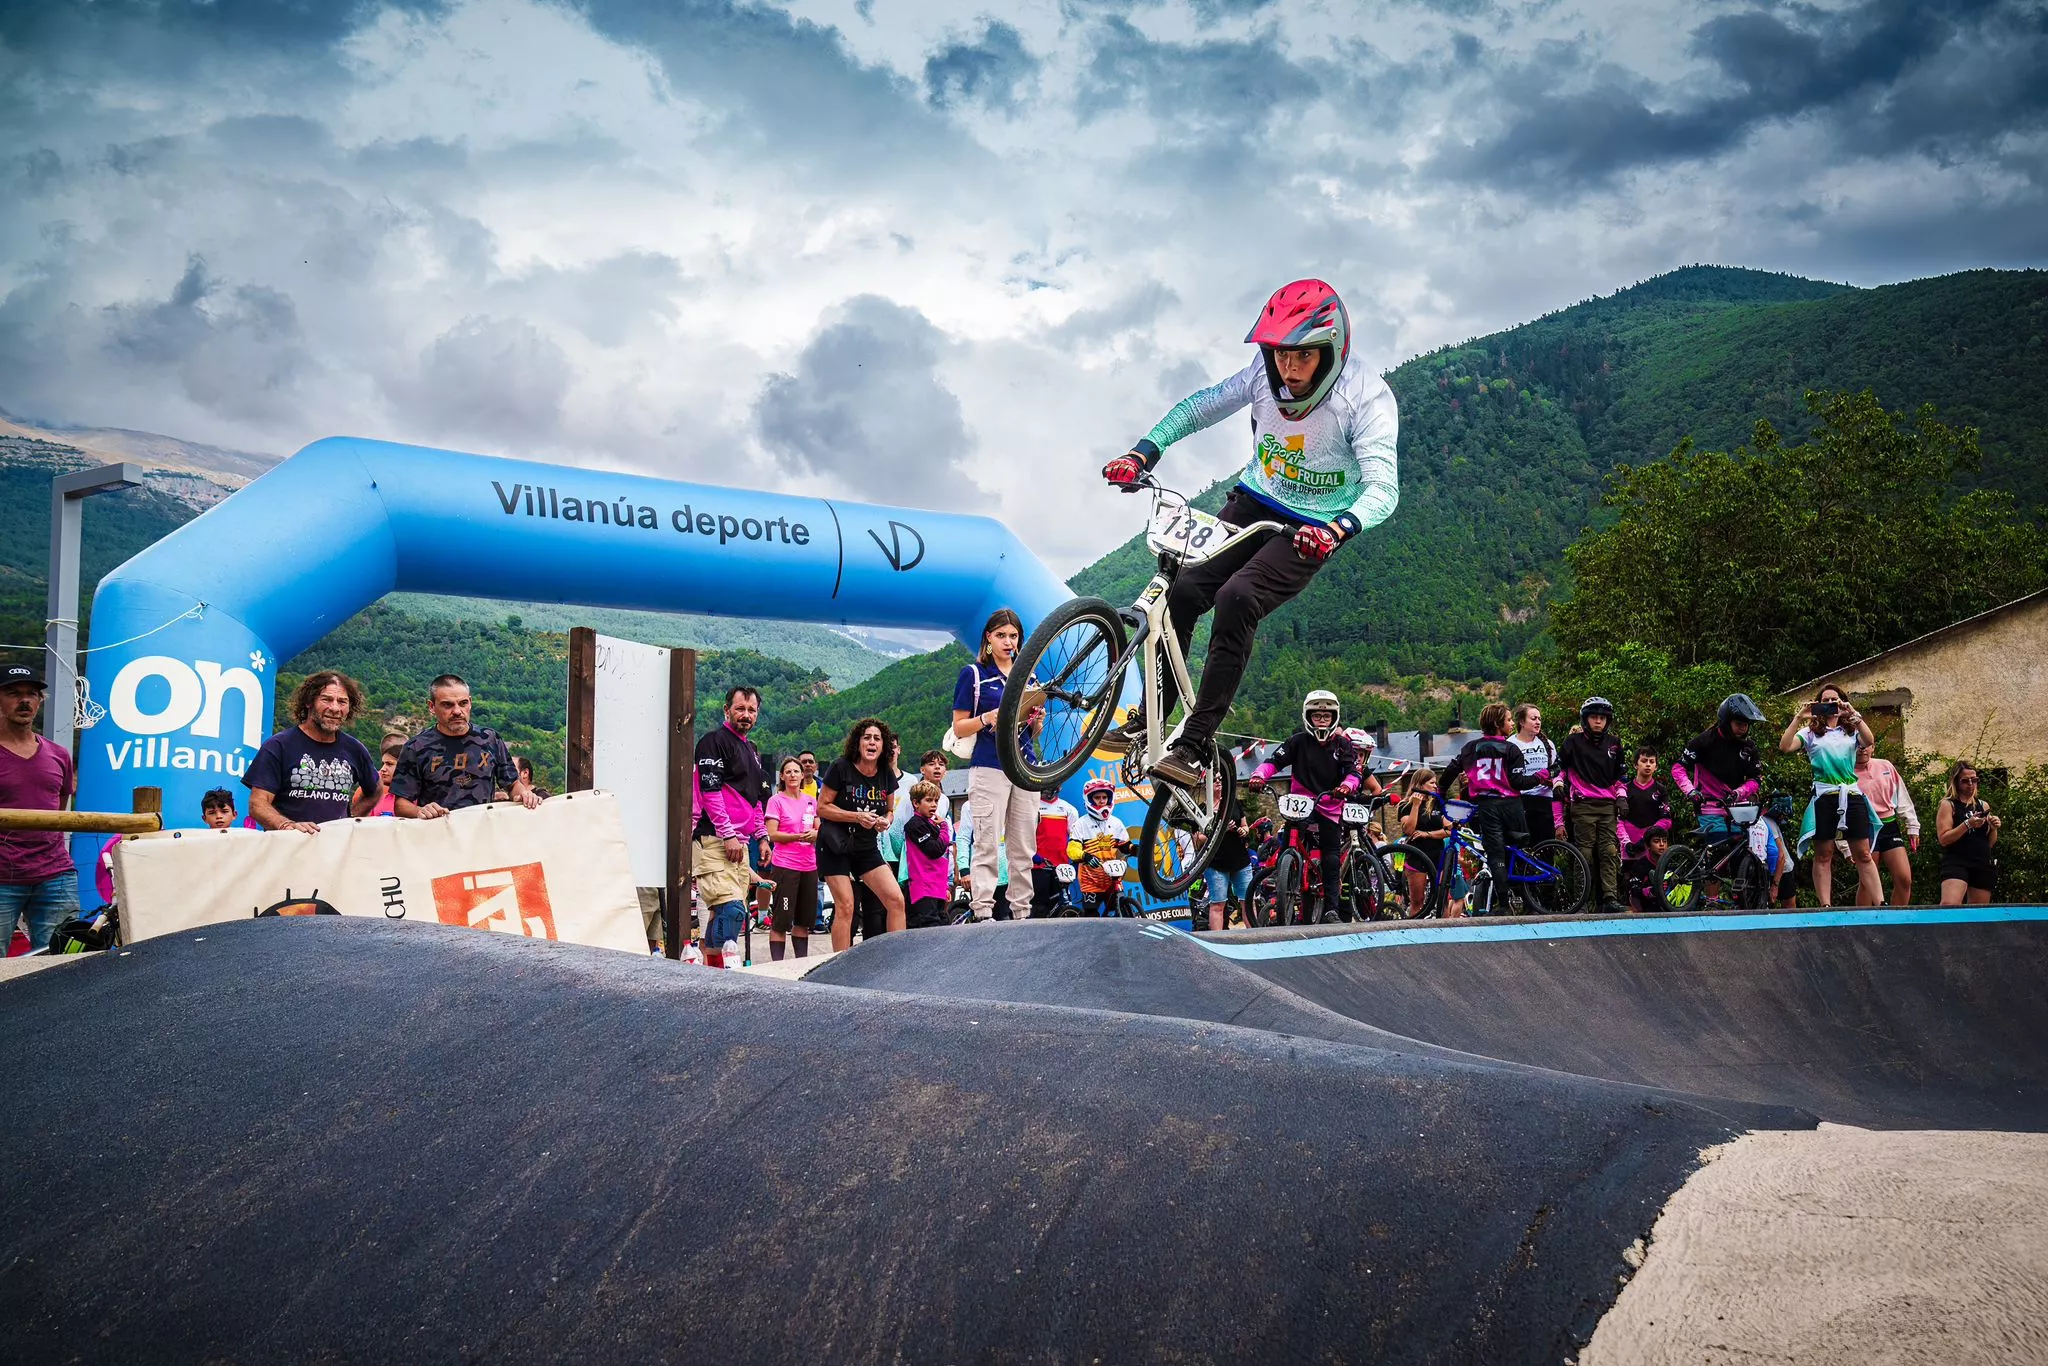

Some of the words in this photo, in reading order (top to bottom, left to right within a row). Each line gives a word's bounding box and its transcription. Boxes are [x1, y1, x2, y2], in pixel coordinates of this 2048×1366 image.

[1261, 433, 1306, 464] Sport
[491, 480, 659, 530] Villanúa
[671, 504, 811, 546] deporte
[1163, 515, 1214, 549] 138
[109, 655, 264, 750] on
[105, 737, 254, 778] Villanú
[431, 752, 490, 773] FOX
[1476, 757, 1503, 781] 21
[288, 789, 331, 800] IRELAND
[1285, 797, 1308, 813] 132
[1344, 806, 1364, 820] 125
[1108, 862, 1126, 874] 131
[1162, 909, 1172, 919] DE
